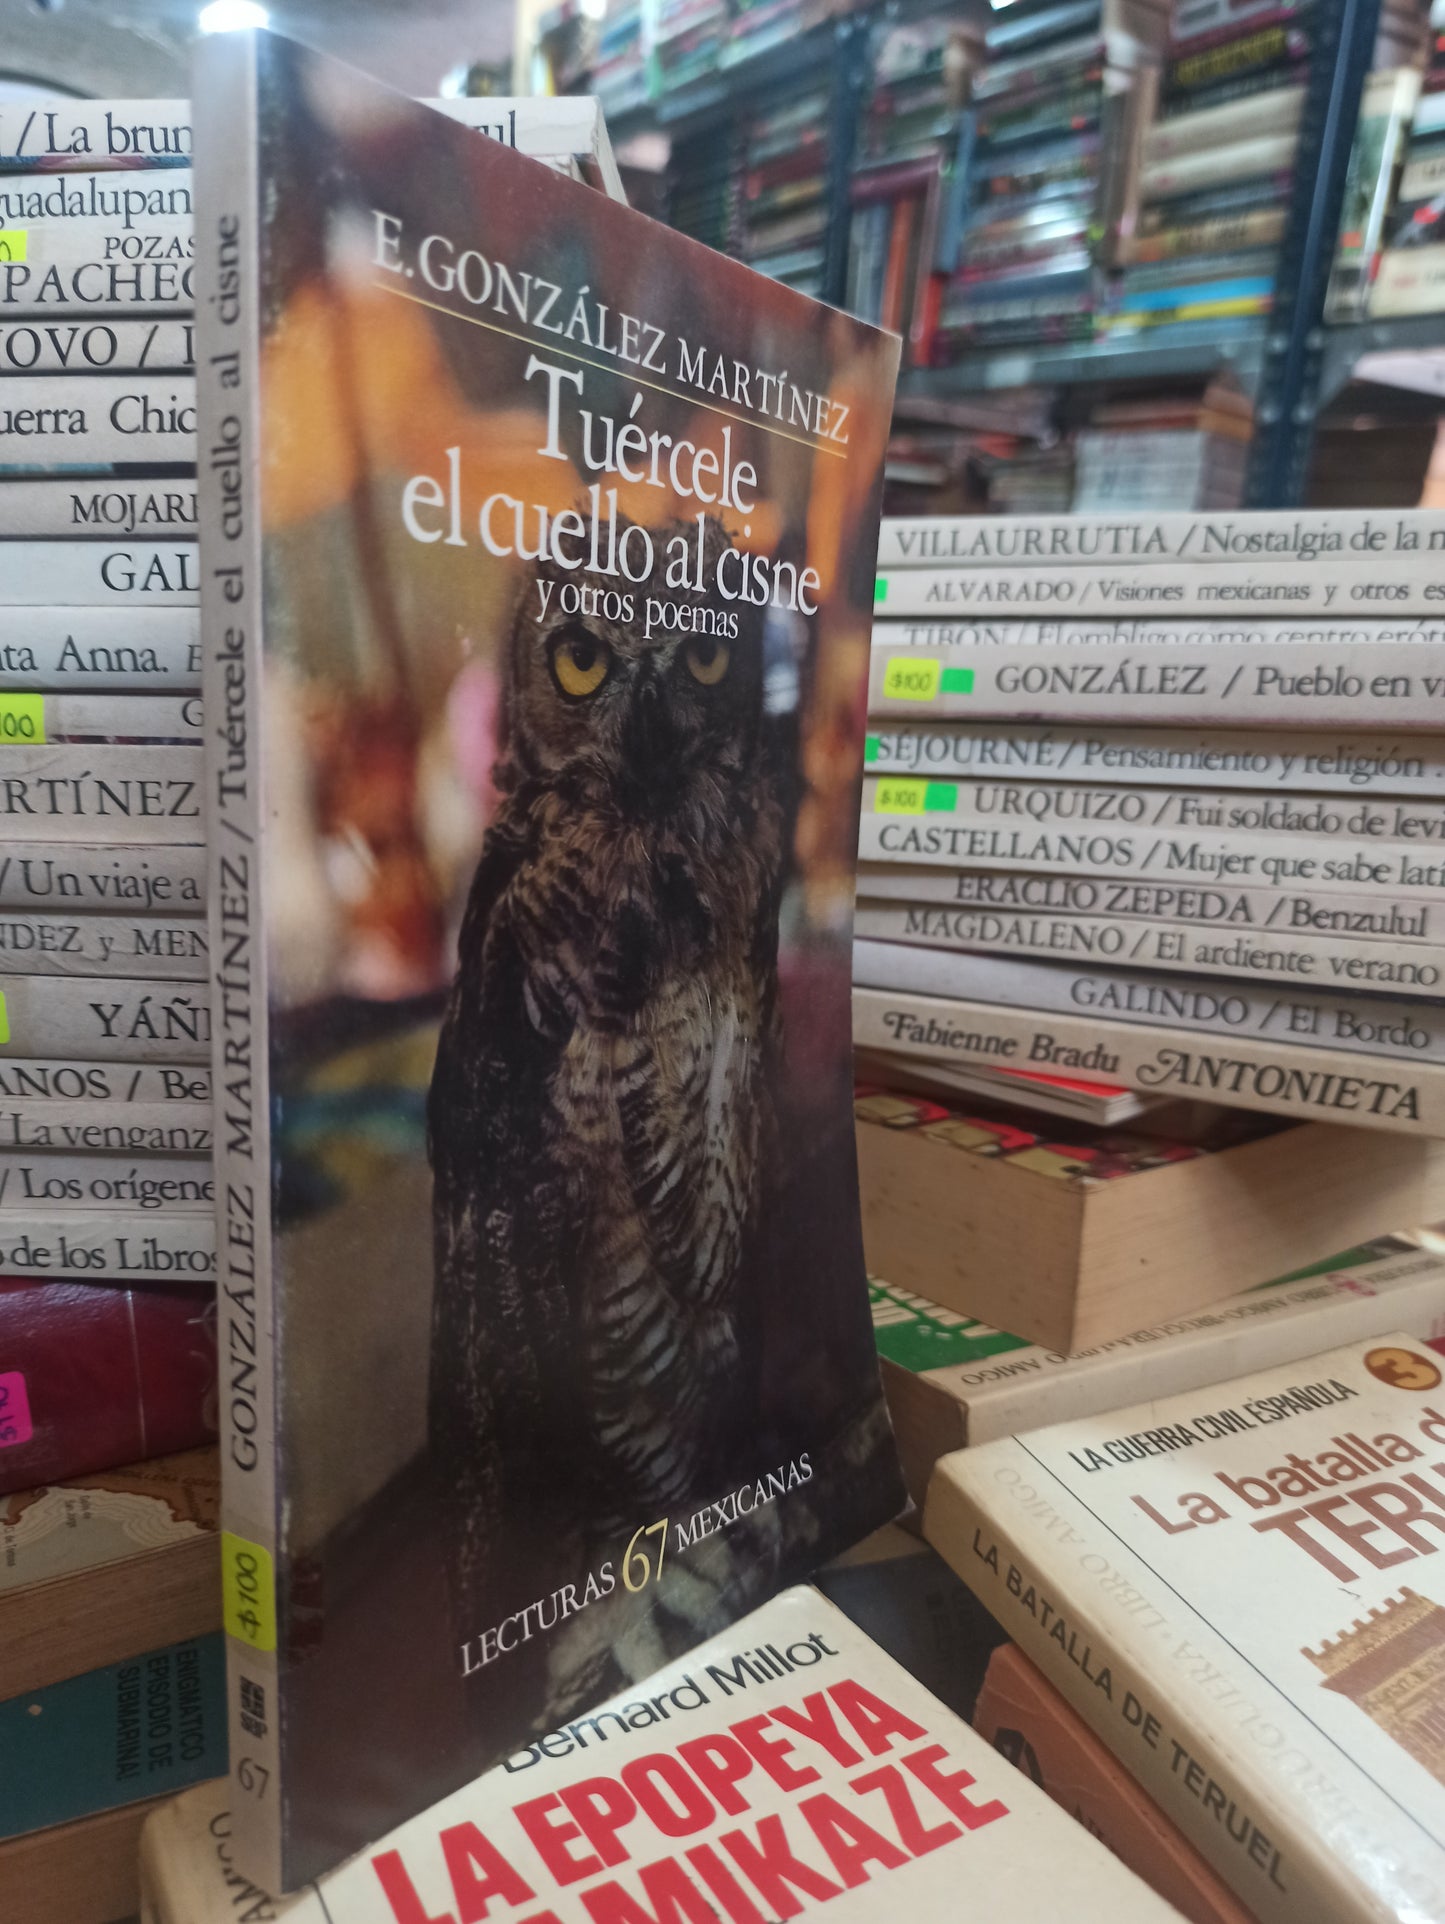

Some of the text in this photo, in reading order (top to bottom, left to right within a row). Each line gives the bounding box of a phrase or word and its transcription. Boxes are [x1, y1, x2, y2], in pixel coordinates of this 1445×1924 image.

[44, 113, 93, 154] La
[208, 214, 240, 326] cisne
[209, 351, 241, 389] al
[676, 336, 851, 445] MARTÍNEZ
[524, 354, 758, 515] Tuércele
[210, 415, 243, 541] cuello
[402, 446, 822, 617] el cuello al cisne
[896, 525, 1168, 558] VILLAURRUTIA
[1201, 523, 1342, 561] Nostalgia
[1350, 520, 1387, 551] de
[1393, 521, 1420, 551] la
[213, 566, 244, 603] el
[535, 577, 740, 640] y otros poemas
[925, 581, 1075, 602] ALVARADO
[1097, 579, 1184, 601] Visiones
[1197, 577, 1311, 601] mexicanas
[1324, 584, 1338, 607] y
[1350, 582, 1410, 601] otros
[55, 635, 169, 672] Anna.
[995, 657, 1207, 696] GONZÁLEZ
[1253, 664, 1363, 697] Pueblo
[1369, 674, 1411, 697] en
[215, 626, 247, 808] Tuércele
[878, 728, 1055, 769] SÉJOURNÉ
[1081, 738, 1272, 773] Pensamiento
[1278, 754, 1297, 781] y
[1303, 745, 1425, 785] religión
[973, 786, 1147, 823] URQUIZO
[1176, 797, 1223, 827] Fui
[1227, 801, 1342, 834] soldado
[1347, 804, 1386, 836] de
[18, 860, 83, 896] Un
[88, 863, 172, 907] viaje
[878, 824, 1134, 867] CASTELLANOS
[1165, 841, 1256, 880] Mujer
[1260, 856, 1317, 886] que
[1321, 851, 1392, 883] sabe
[955, 873, 1099, 911] ERACLIO
[1104, 884, 1254, 924] ZEPEDA
[1288, 896, 1428, 937] Benzulul
[903, 907, 1124, 956] MAGDALENO
[1153, 930, 1184, 962] El
[1194, 937, 1315, 975] ardiente
[1327, 954, 1440, 987] verano
[216, 853, 253, 1160] MARTÍNEZ
[1070, 976, 1249, 1026] GALINDO
[1286, 1003, 1321, 1035] El
[1333, 1008, 1432, 1050] Bordo
[882, 1010, 1122, 1074] Fabienne Bradu
[1136, 1047, 1421, 1120] ANTONIETA
[11, 1113, 53, 1146] La
[20, 1168, 83, 1199] Los
[11, 1235, 51, 1268] de
[59, 1236, 106, 1269] los
[224, 1184, 257, 1472] GONZÁLEZ
[960, 1357, 1042, 1386] AMIGO
[1067, 1377, 1360, 1473] LA GUERRA CIVIL ESPAÑOLA
[993, 1466, 1088, 1549] AMIGO
[1129, 1491, 1233, 1536] La
[1213, 1431, 1427, 1510] batalla
[460, 1452, 814, 1679] LECTURAS 67 MEXICANAS
[704, 1631, 840, 1697] Millot
[147, 1655, 174, 1773] EPISODIO DE
[173, 1650, 206, 1763] ENIGMATICO
[972, 1527, 1000, 1576] LA
[1005, 1566, 1114, 1704] BATALLA
[1121, 1690, 1163, 1751] DE
[1168, 1737, 1288, 1894] TERUEL
[371, 1820, 538, 1924] LA
[511, 1678, 930, 1888] EPOPEYA
